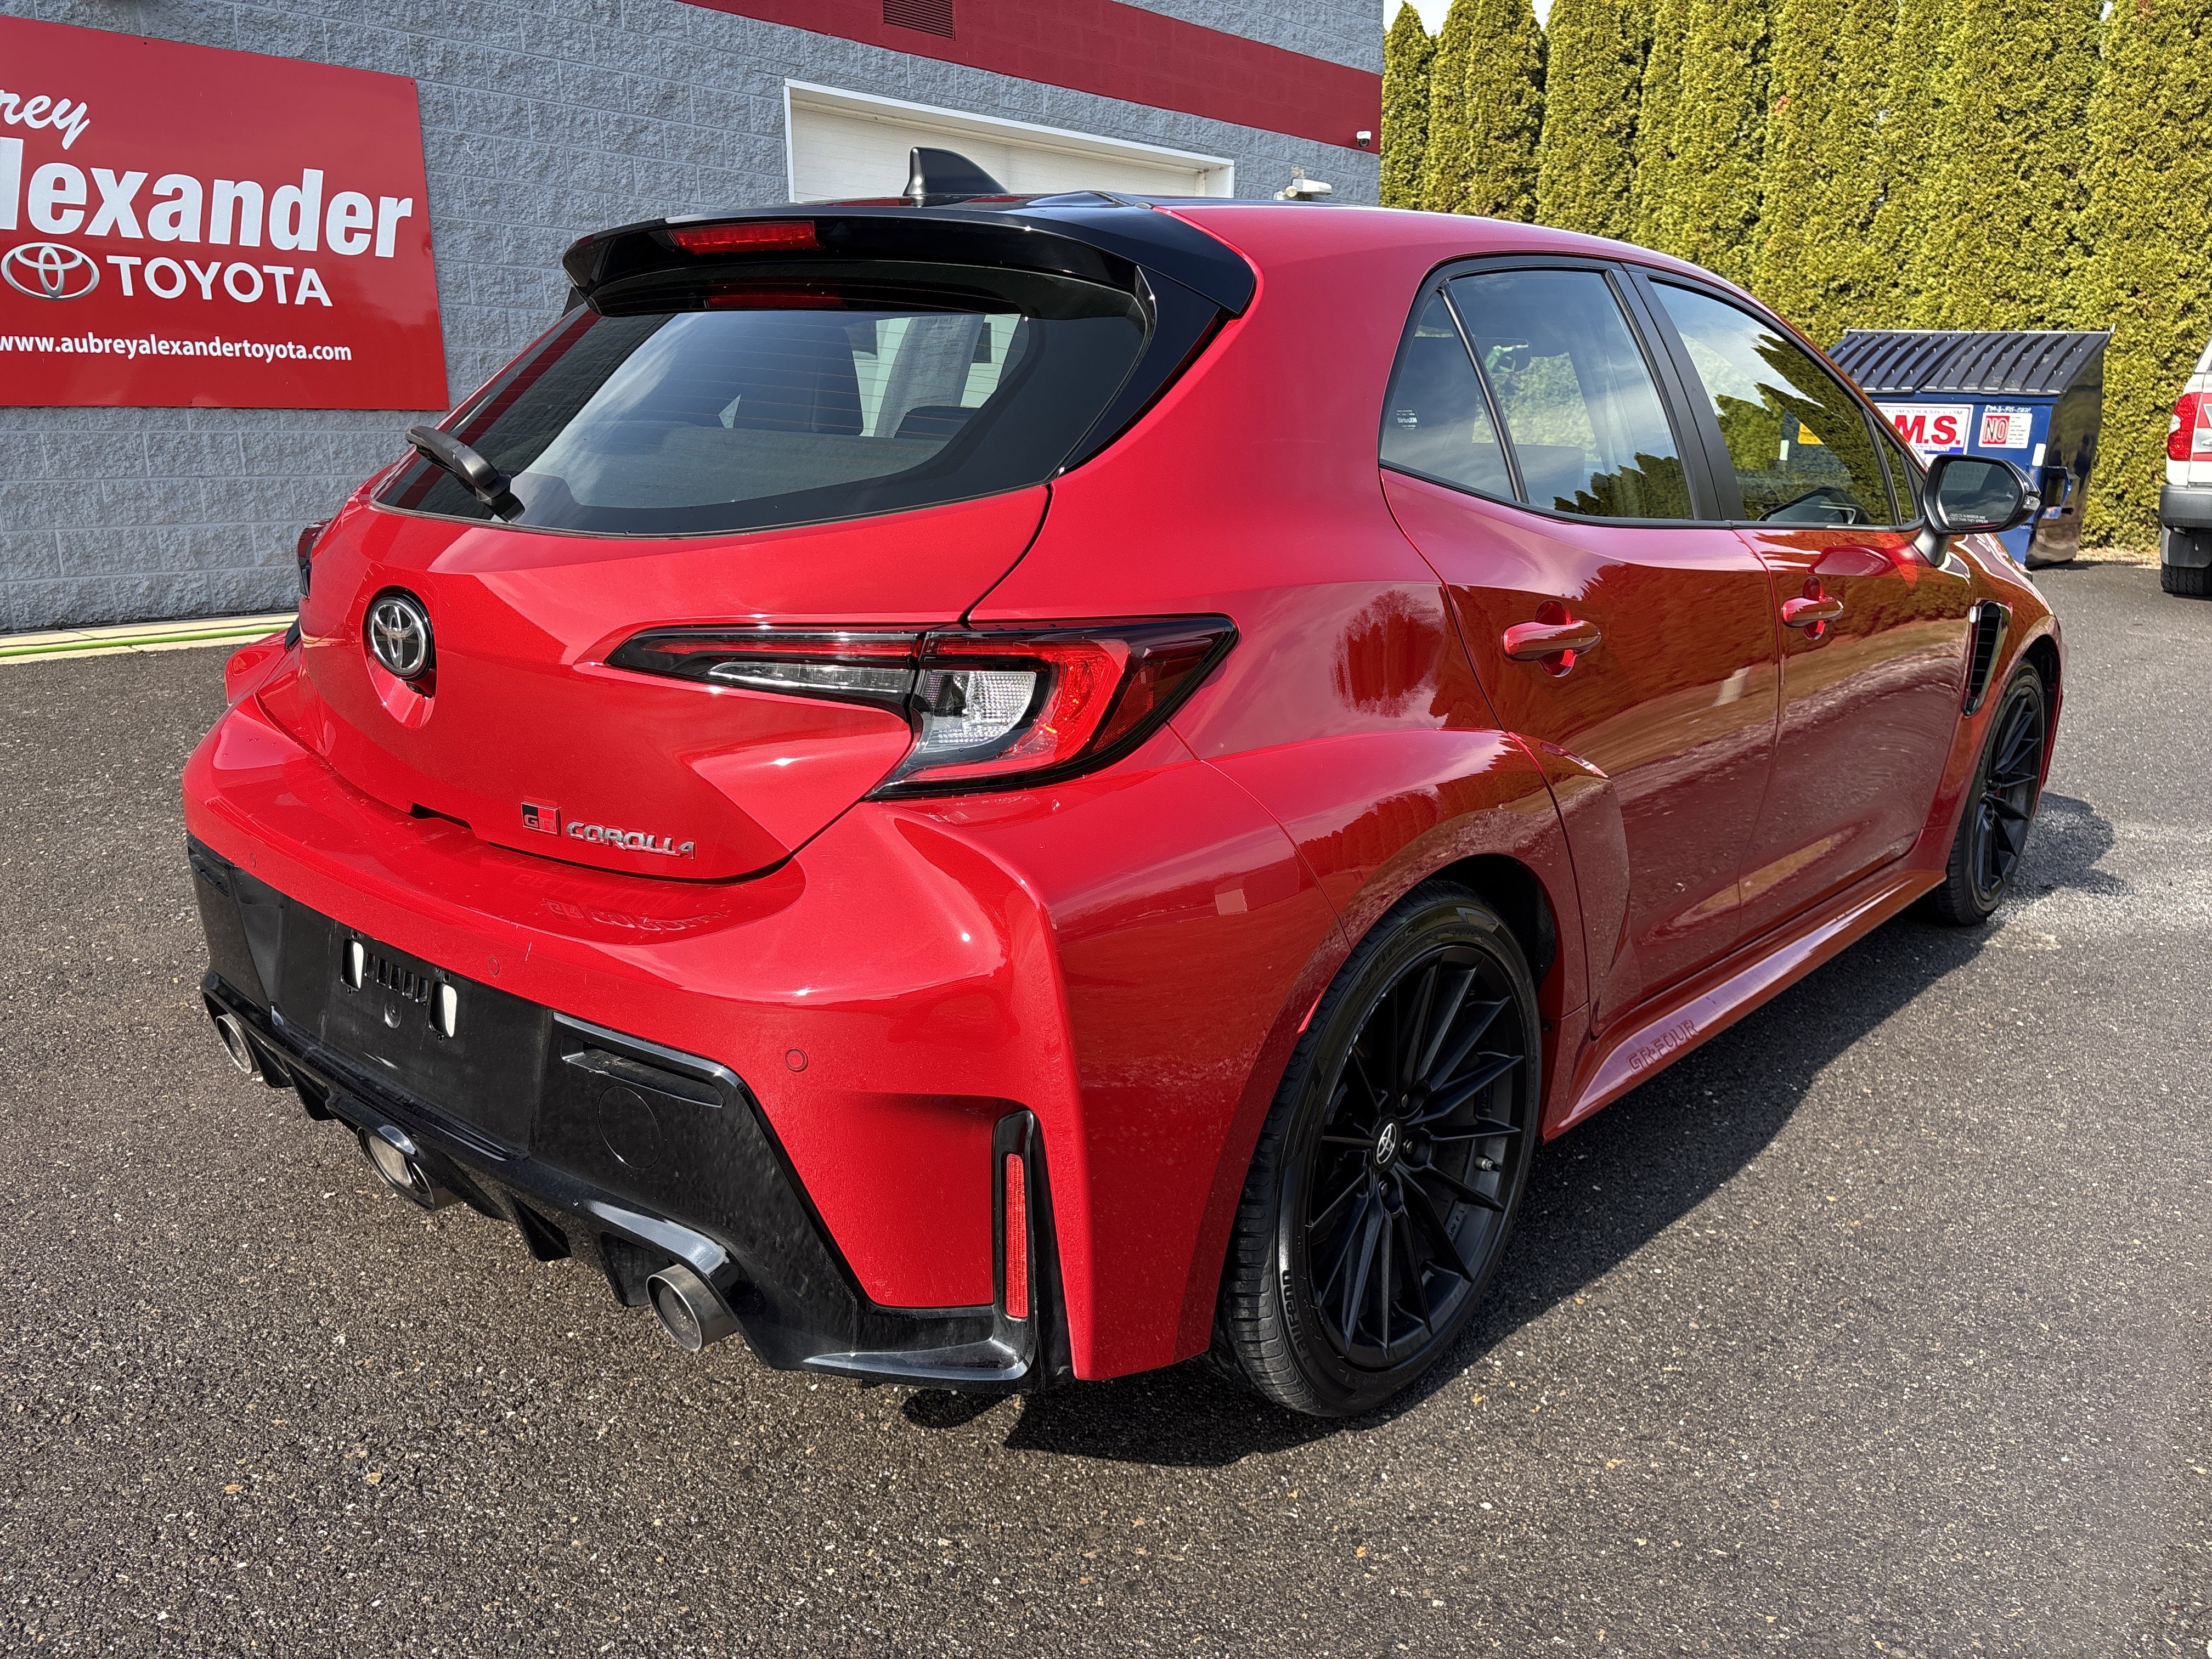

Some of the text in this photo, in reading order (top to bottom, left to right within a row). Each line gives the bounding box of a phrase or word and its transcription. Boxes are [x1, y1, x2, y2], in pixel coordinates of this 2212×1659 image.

[0, 89, 91, 150] rey
[0, 136, 413, 258] lexander
[106, 256, 333, 307] TOYOTA
[0, 331, 352, 364] www.aubreyalexandertoyota.com
[1983, 417, 2008, 443] NO
[566, 821, 696, 860] COROLLA
